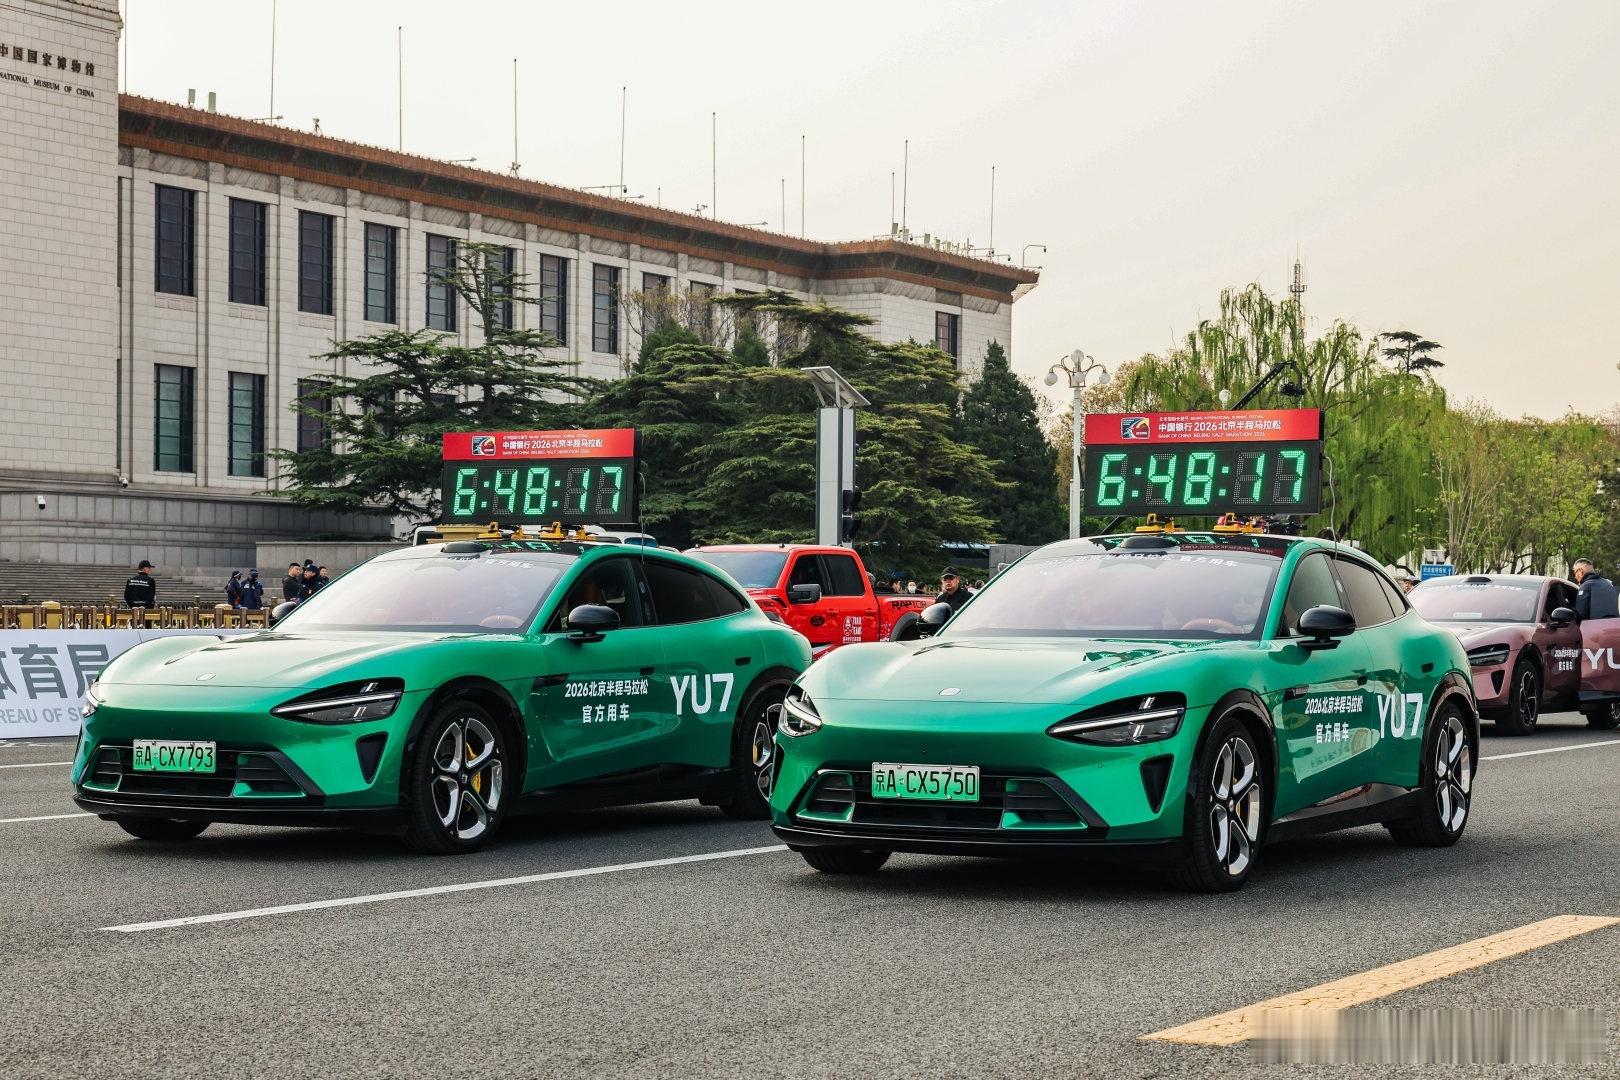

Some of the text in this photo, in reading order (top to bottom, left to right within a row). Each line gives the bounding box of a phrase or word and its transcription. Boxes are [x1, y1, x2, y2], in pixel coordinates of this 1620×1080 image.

[34, 78, 60, 91] MUSEUM
[64, 85, 73, 93] OF
[76, 88, 95, 98] CHINA
[1097, 450, 1306, 506] 6:48:17
[453, 466, 623, 516] 6:48:17
[891, 600, 928, 611] RAPTOR
[564, 679, 649, 698] 2026北京半程马拉松
[669, 672, 735, 716] YU7
[42, 707, 63, 723] OF
[67, 707, 83, 723] S
[582, 702, 630, 724] 官方用车
[1304, 695, 1364, 715] 2026北京半程马拉松
[1377, 692, 1424, 739] YU7
[1315, 721, 1349, 744] 官方用车
